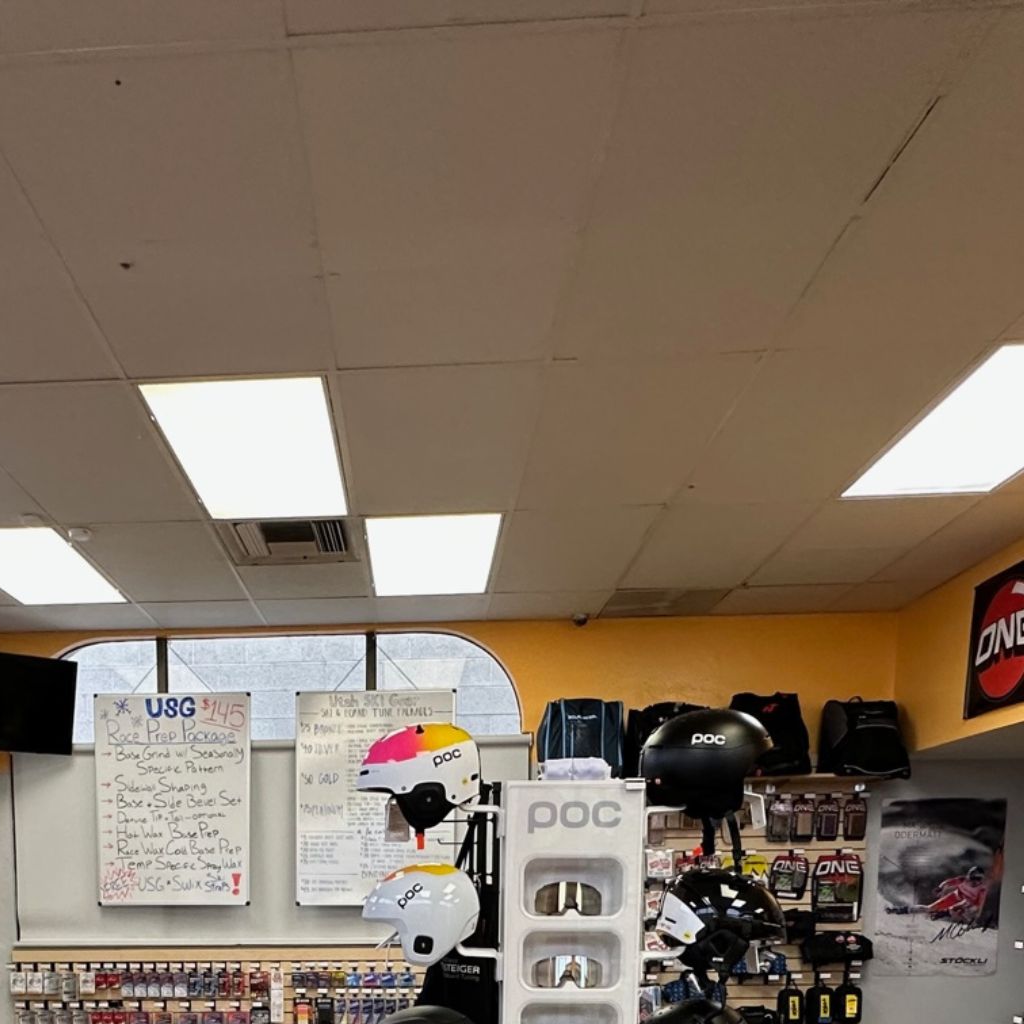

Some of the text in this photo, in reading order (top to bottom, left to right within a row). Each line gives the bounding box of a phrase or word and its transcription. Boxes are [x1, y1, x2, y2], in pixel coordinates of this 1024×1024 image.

[144, 696, 245, 730] USG $145
[106, 718, 235, 744] Race Prep Package
[115, 745, 140, 761] Base
[142, 745, 171, 760] Grind
[158, 777, 207, 795] Shaping
[116, 793, 143, 809] Base
[153, 793, 182, 808] Side
[141, 825, 163, 838] Wax
[198, 821, 219, 839] Prep
[117, 838, 140, 856] Race
[141, 841, 166, 855] Wax
[116, 857, 153, 871] Temp
[773, 860, 807, 873] ONE
[816, 860, 861, 875] ONE
[138, 876, 165, 892] USG
